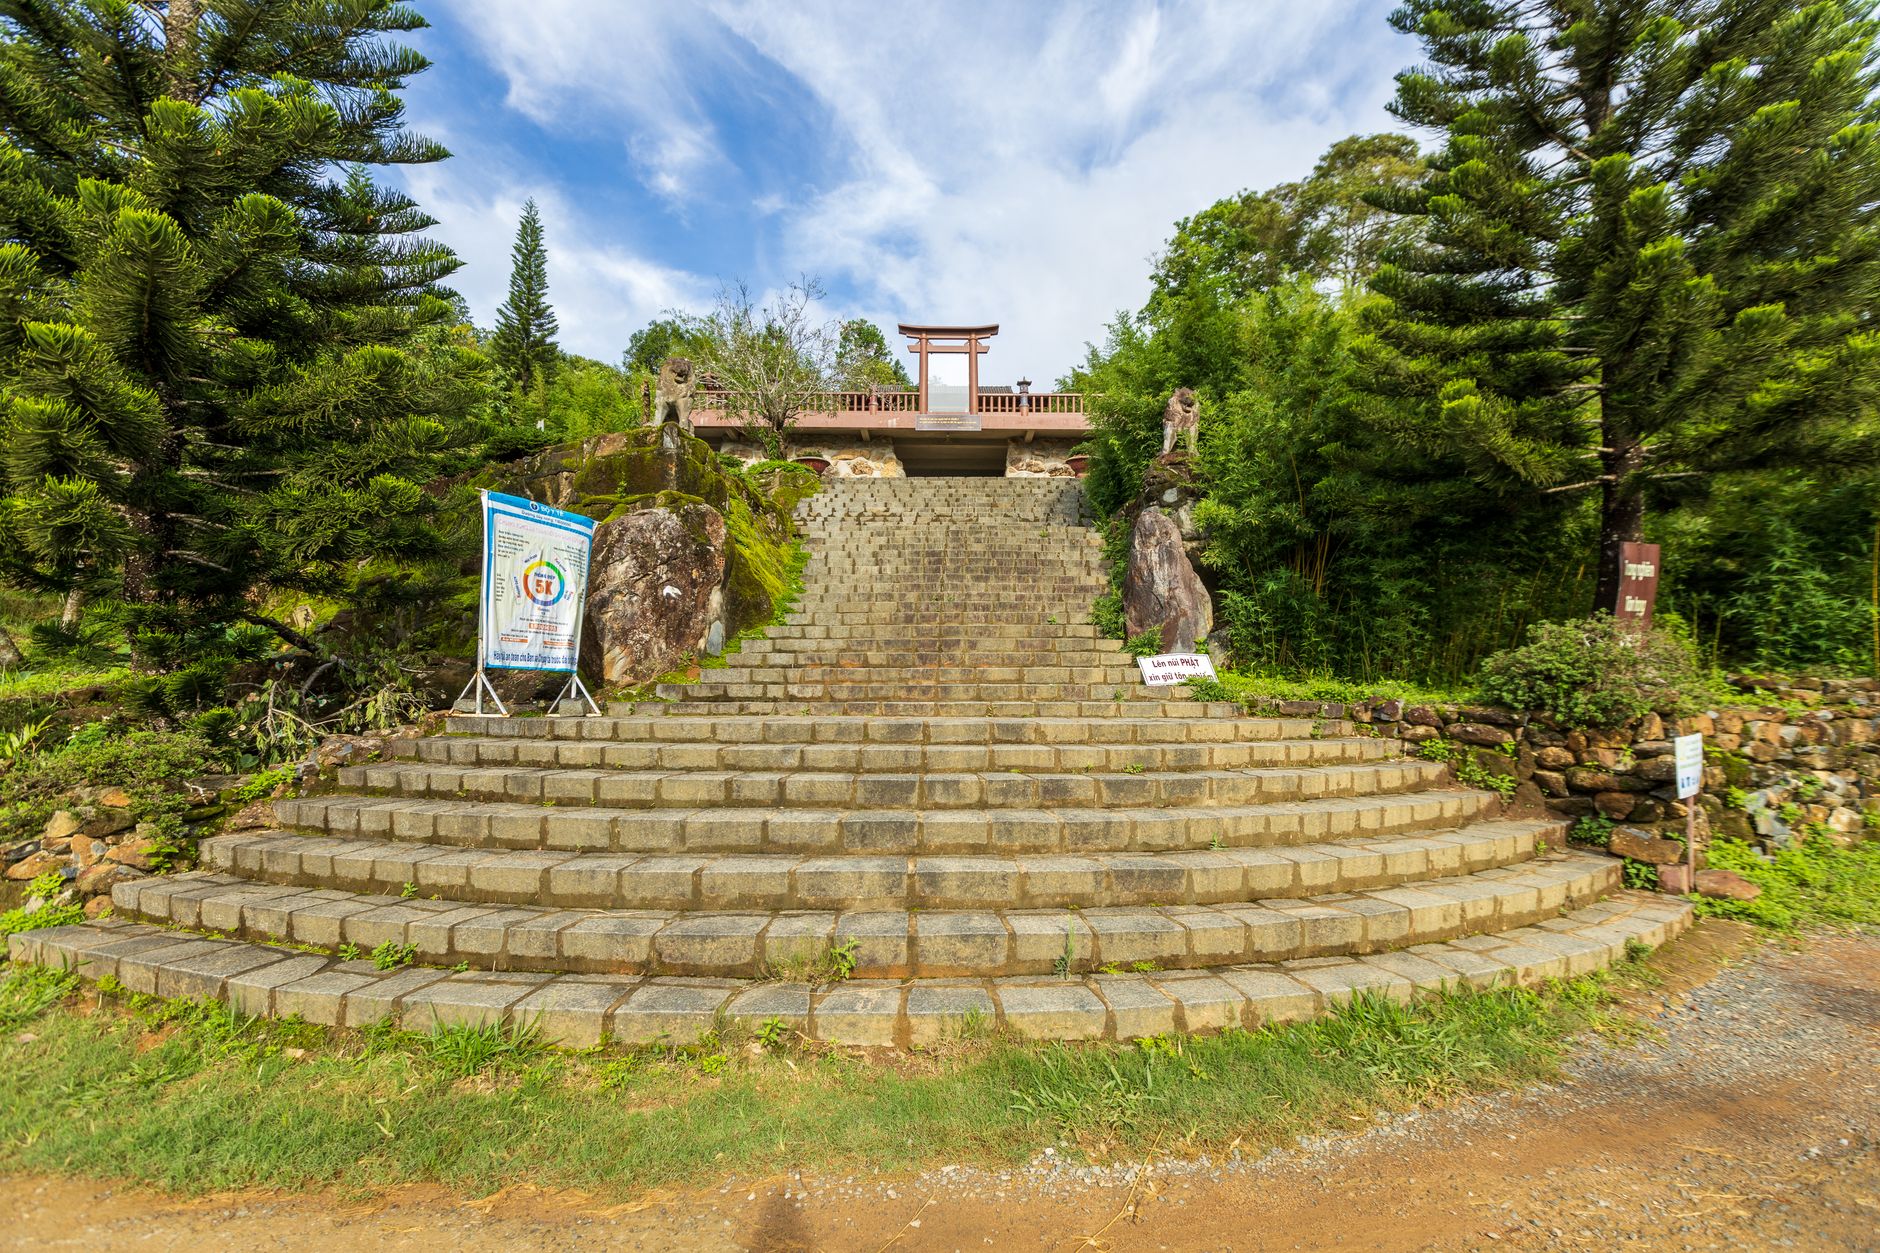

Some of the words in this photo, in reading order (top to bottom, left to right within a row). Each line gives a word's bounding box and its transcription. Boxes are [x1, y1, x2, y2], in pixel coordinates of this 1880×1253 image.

[535, 579, 553, 595] 5K
[1152, 659, 1167, 668] Lên
[1167, 659, 1180, 667] núi
[1180, 657, 1200, 669] PHẬT
[1148, 673, 1160, 681] xin
[1161, 672, 1173, 682] giữ
[1174, 672, 1187, 680] tôn
